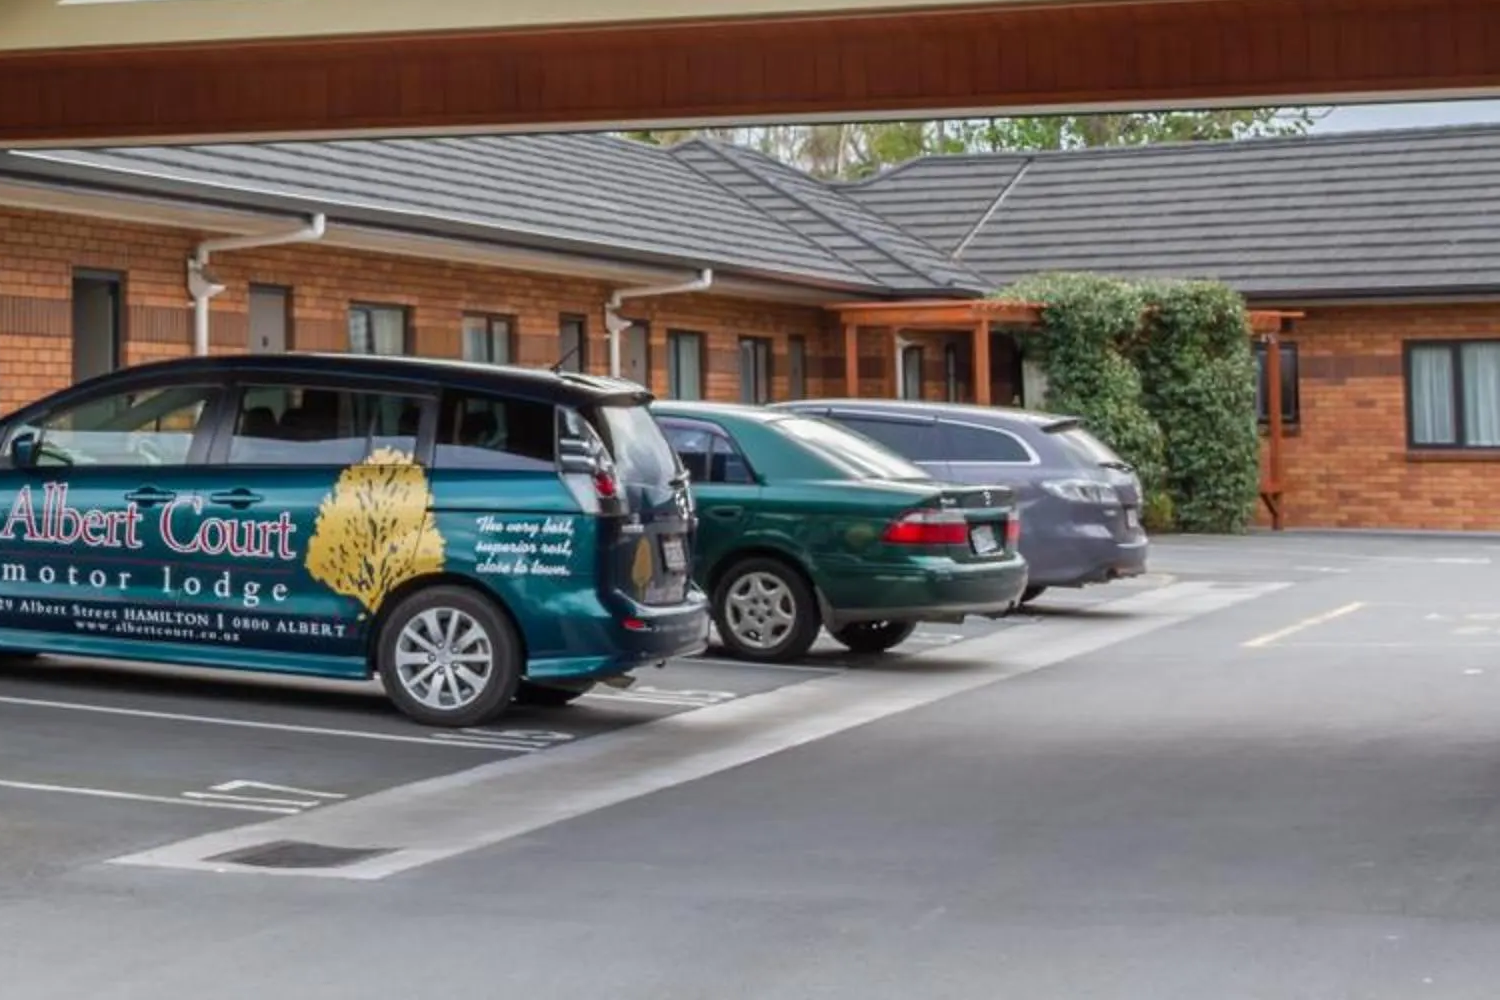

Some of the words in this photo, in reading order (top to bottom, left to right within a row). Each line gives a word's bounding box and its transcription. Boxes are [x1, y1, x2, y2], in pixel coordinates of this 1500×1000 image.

[160, 494, 297, 560] Court
[476, 515, 504, 533] The
[2, 563, 132, 590] motor
[163, 565, 288, 607] lodge
[20, 601, 67, 616] Albert
[73, 604, 117, 619] Street
[124, 608, 208, 627] HAMILTON
[232, 618, 269, 631] 0800
[277, 619, 345, 638] ALBERT
